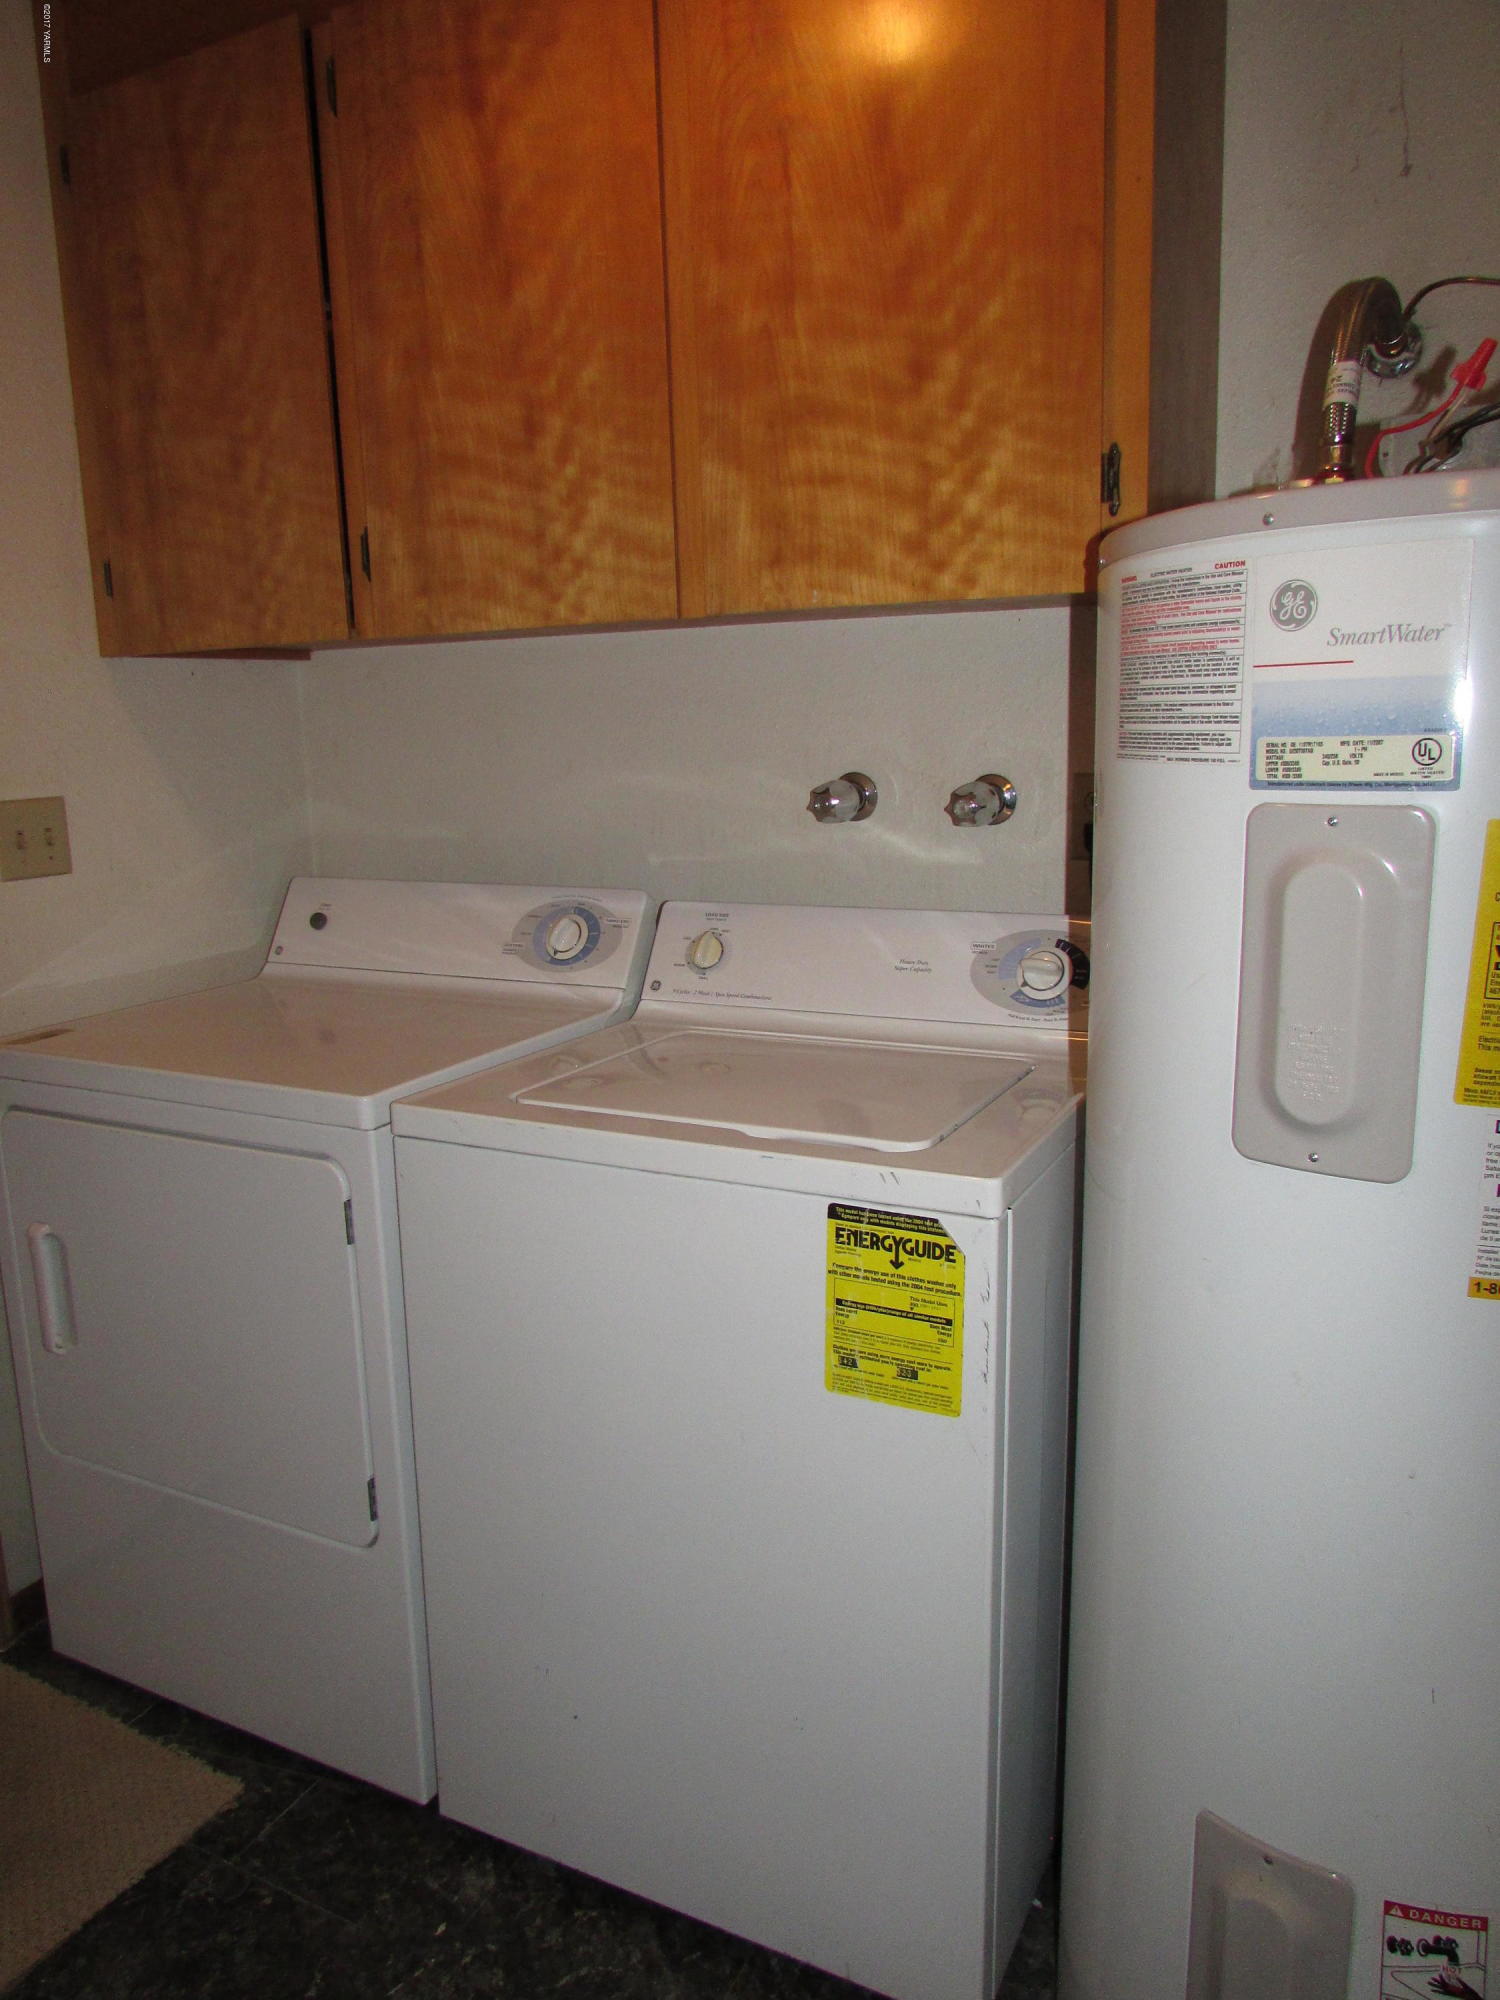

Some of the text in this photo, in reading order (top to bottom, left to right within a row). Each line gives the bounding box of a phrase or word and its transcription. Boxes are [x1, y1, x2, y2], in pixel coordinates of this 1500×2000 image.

[1214, 560, 1246, 570] CAUTION
[1326, 623, 1446, 646] SmartWater
[835, 1226, 956, 1264] ENERGYGUIDE
[1410, 1909, 1482, 1928] DANGER
